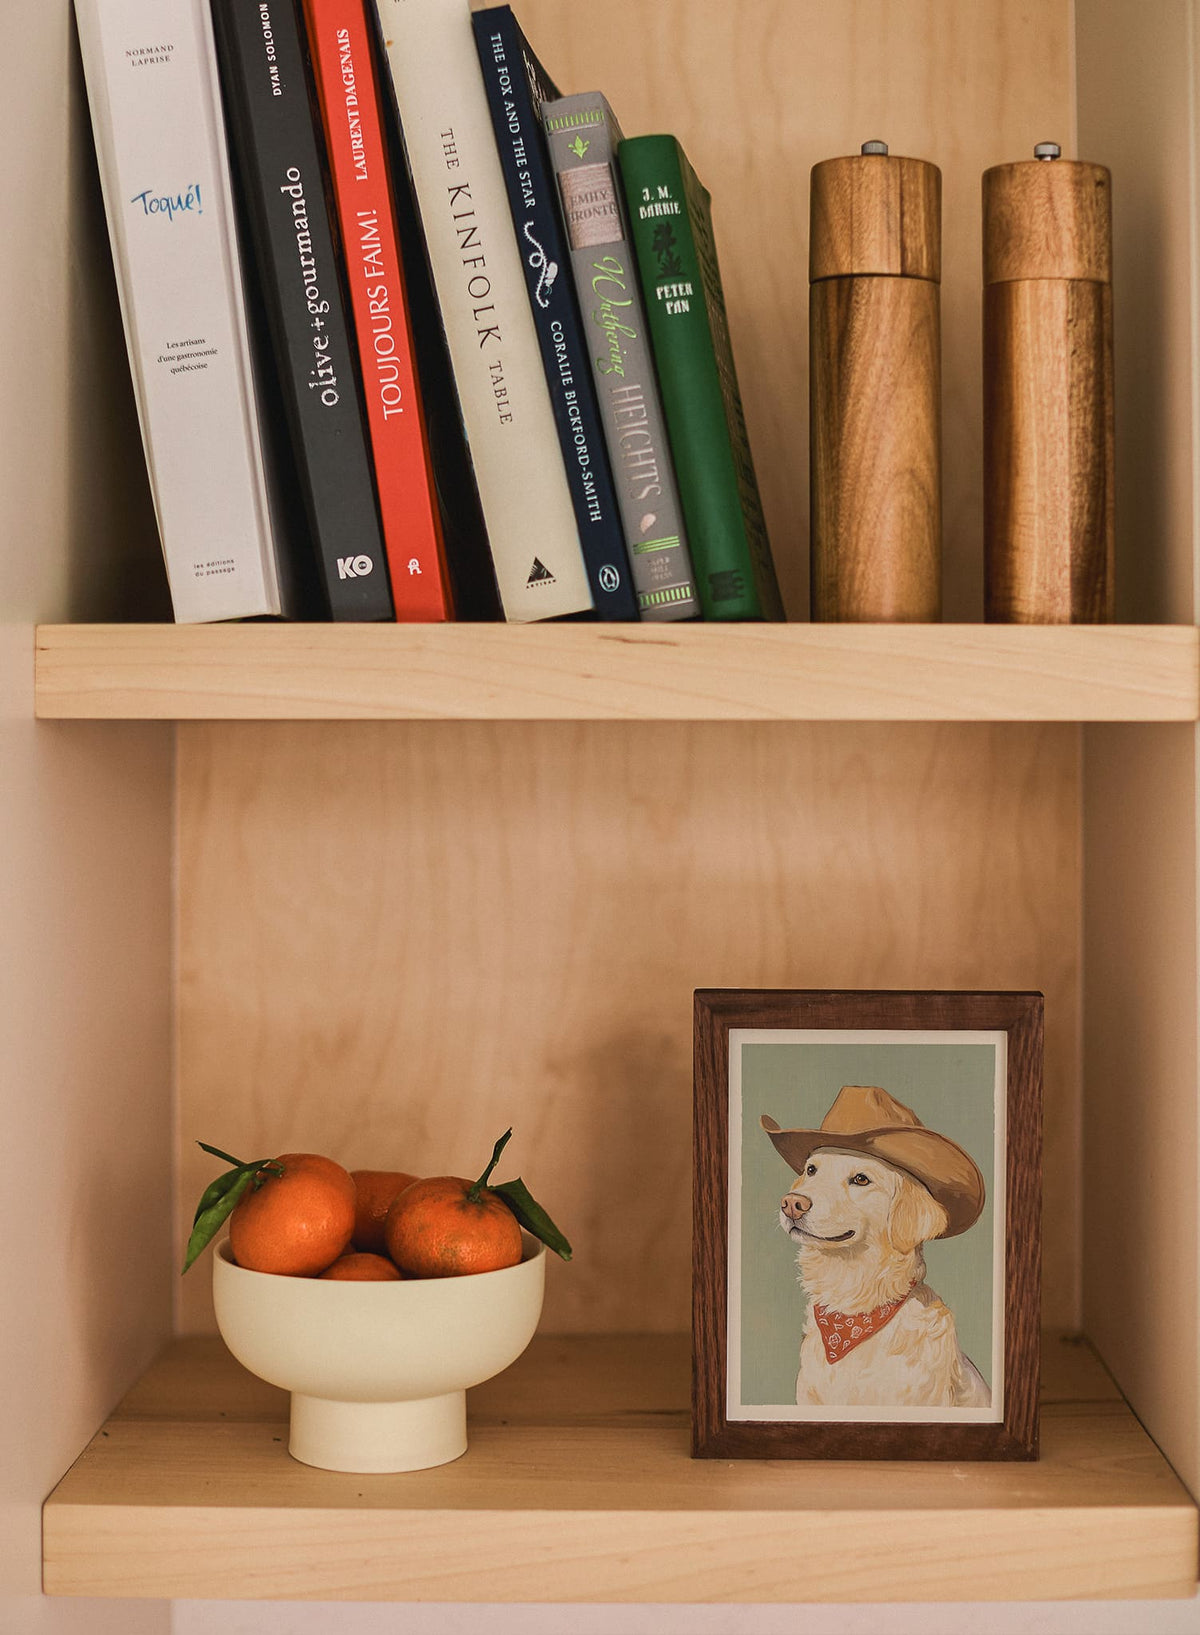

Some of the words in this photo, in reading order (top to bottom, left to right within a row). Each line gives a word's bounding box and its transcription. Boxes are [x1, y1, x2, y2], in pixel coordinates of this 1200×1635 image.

[259, 3, 276, 62] SOLOMON
[490, 33, 505, 63] THE
[125, 44, 174, 57] NORMAND
[131, 55, 170, 67] LAPRISE
[336, 28, 358, 106] DAGENAIS
[269, 66, 282, 96] DYAN
[497, 66, 513, 96] FOX
[504, 101, 520, 134] AND
[346, 110, 368, 181] LAURENT
[440, 128, 459, 169] THE
[513, 138, 527, 168] THE
[131, 184, 203, 222] Toqué!
[519, 171, 536, 208] STAR
[639, 201, 681, 220] BARRIE
[356, 209, 385, 278] FAIM!
[447, 182, 502, 349] KINFOLK
[656, 282, 693, 301] PETER
[665, 299, 690, 315] PAN
[592, 256, 637, 378] Wuthering
[166, 342, 179, 350] Les
[179, 338, 206, 347] artisans
[176, 347, 218, 361] gastronomie
[367, 285, 403, 421] TOUJOURS
[170, 362, 208, 375] québécoise
[489, 361, 512, 425] TABLE
[550, 320, 574, 387] CORALIE
[564, 390, 602, 523] BICKFORD-SMITH
[610, 384, 662, 500] HEIGHTS
[336, 554, 374, 580] KO
